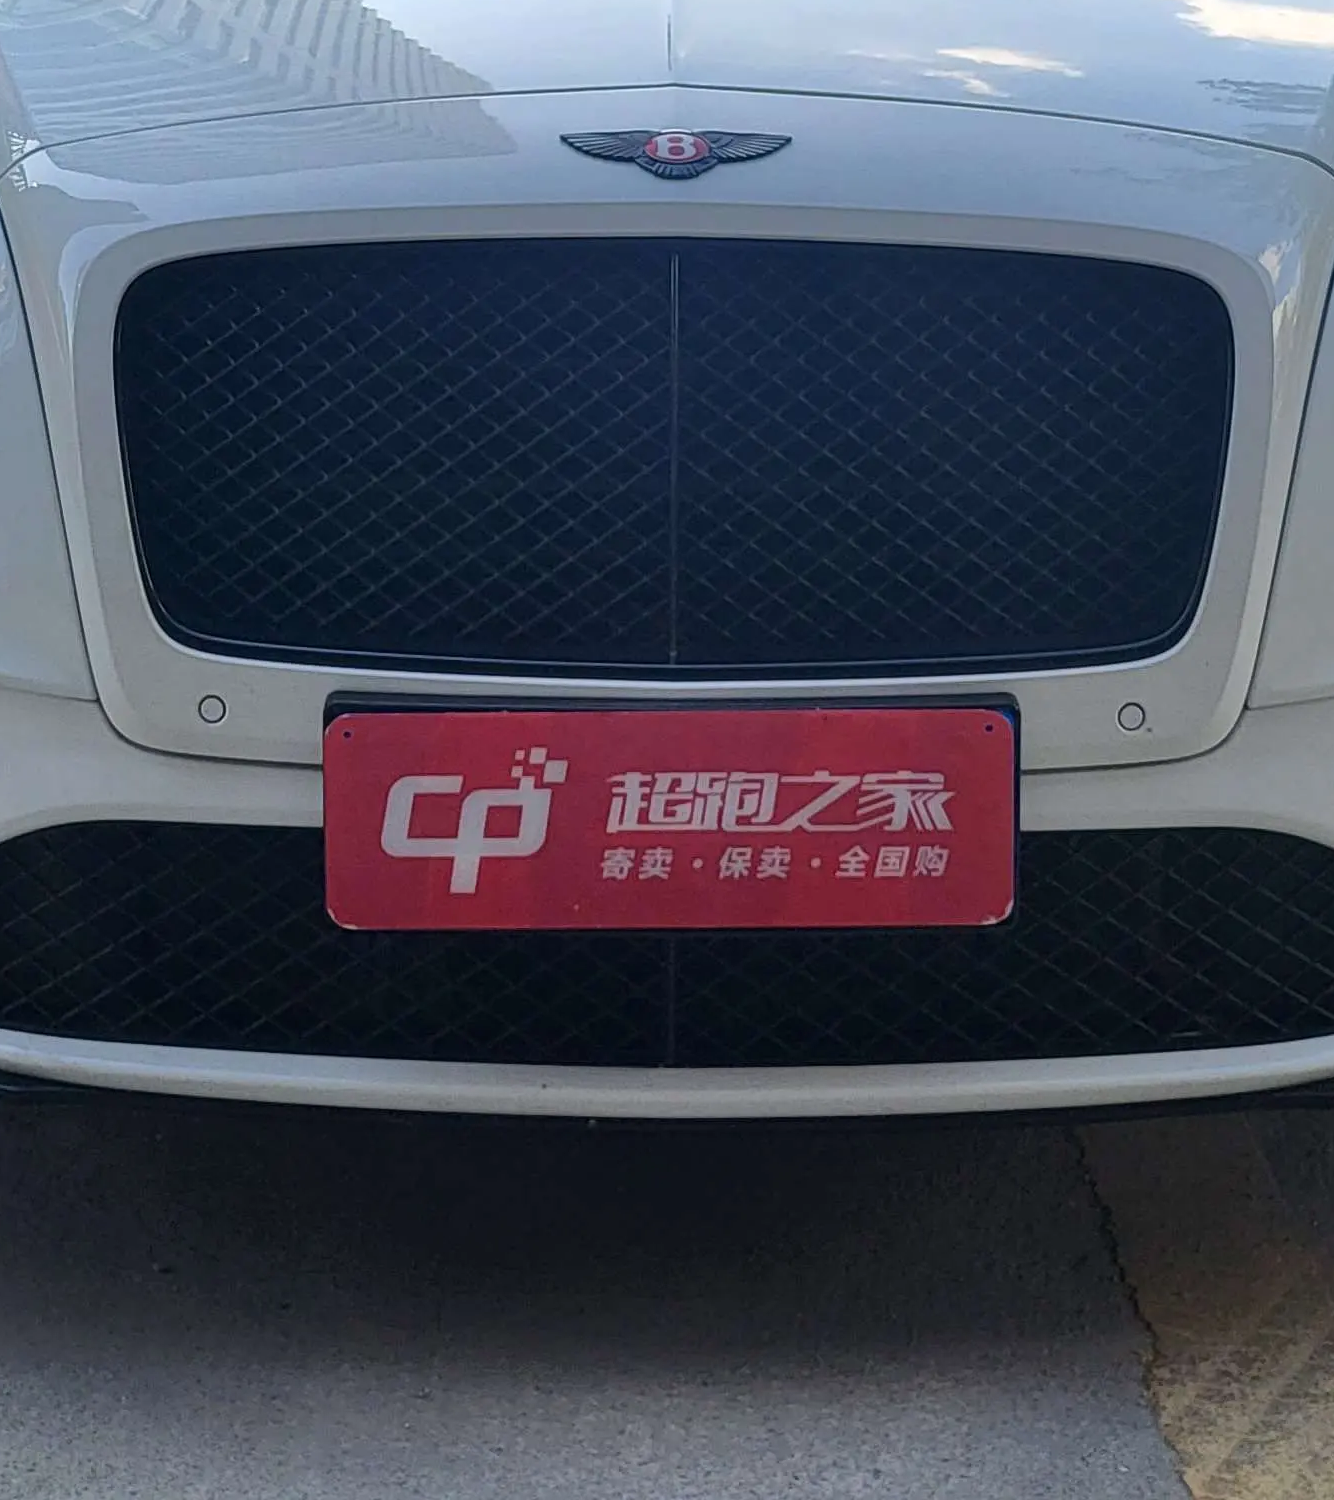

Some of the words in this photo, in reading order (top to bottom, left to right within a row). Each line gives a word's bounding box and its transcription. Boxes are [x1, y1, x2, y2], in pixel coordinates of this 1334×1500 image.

[655, 136, 696, 158] B
[606, 770, 956, 833] 超跑之家
